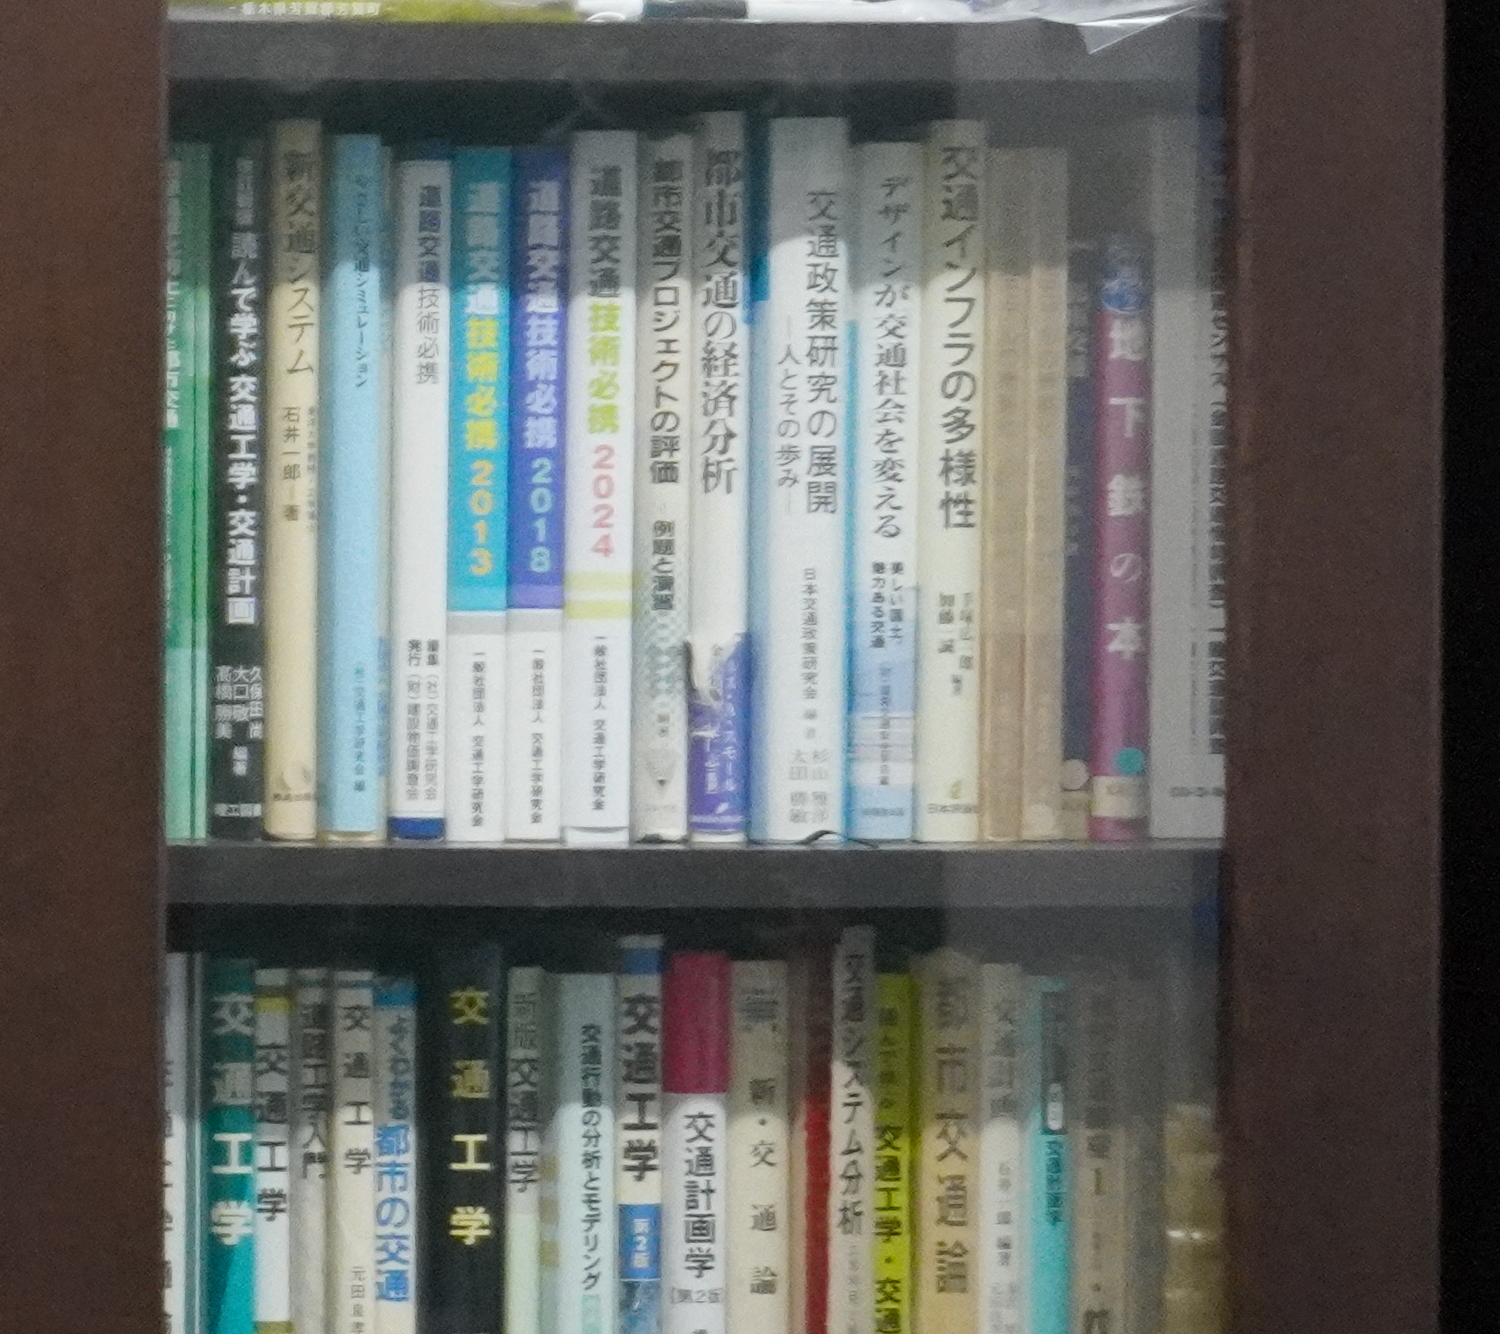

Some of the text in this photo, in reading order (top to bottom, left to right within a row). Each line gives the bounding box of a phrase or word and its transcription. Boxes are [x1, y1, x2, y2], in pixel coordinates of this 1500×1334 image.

[805, 190, 839, 515] 交通政策研究の展開
[938, 146, 980, 531] 交通インフラの多様性
[469, 461, 494, 576] 2013
[528, 458, 553, 572] 2018
[591, 446, 616, 558] 2024
[211, 993, 254, 1247] 交通工学
[449, 987, 491, 1246] 交通工学
[621, 991, 659, 1184] 交通工学
[375, 1123, 413, 1304] 都市の交通
[683, 1111, 717, 1280] 交通計画学
